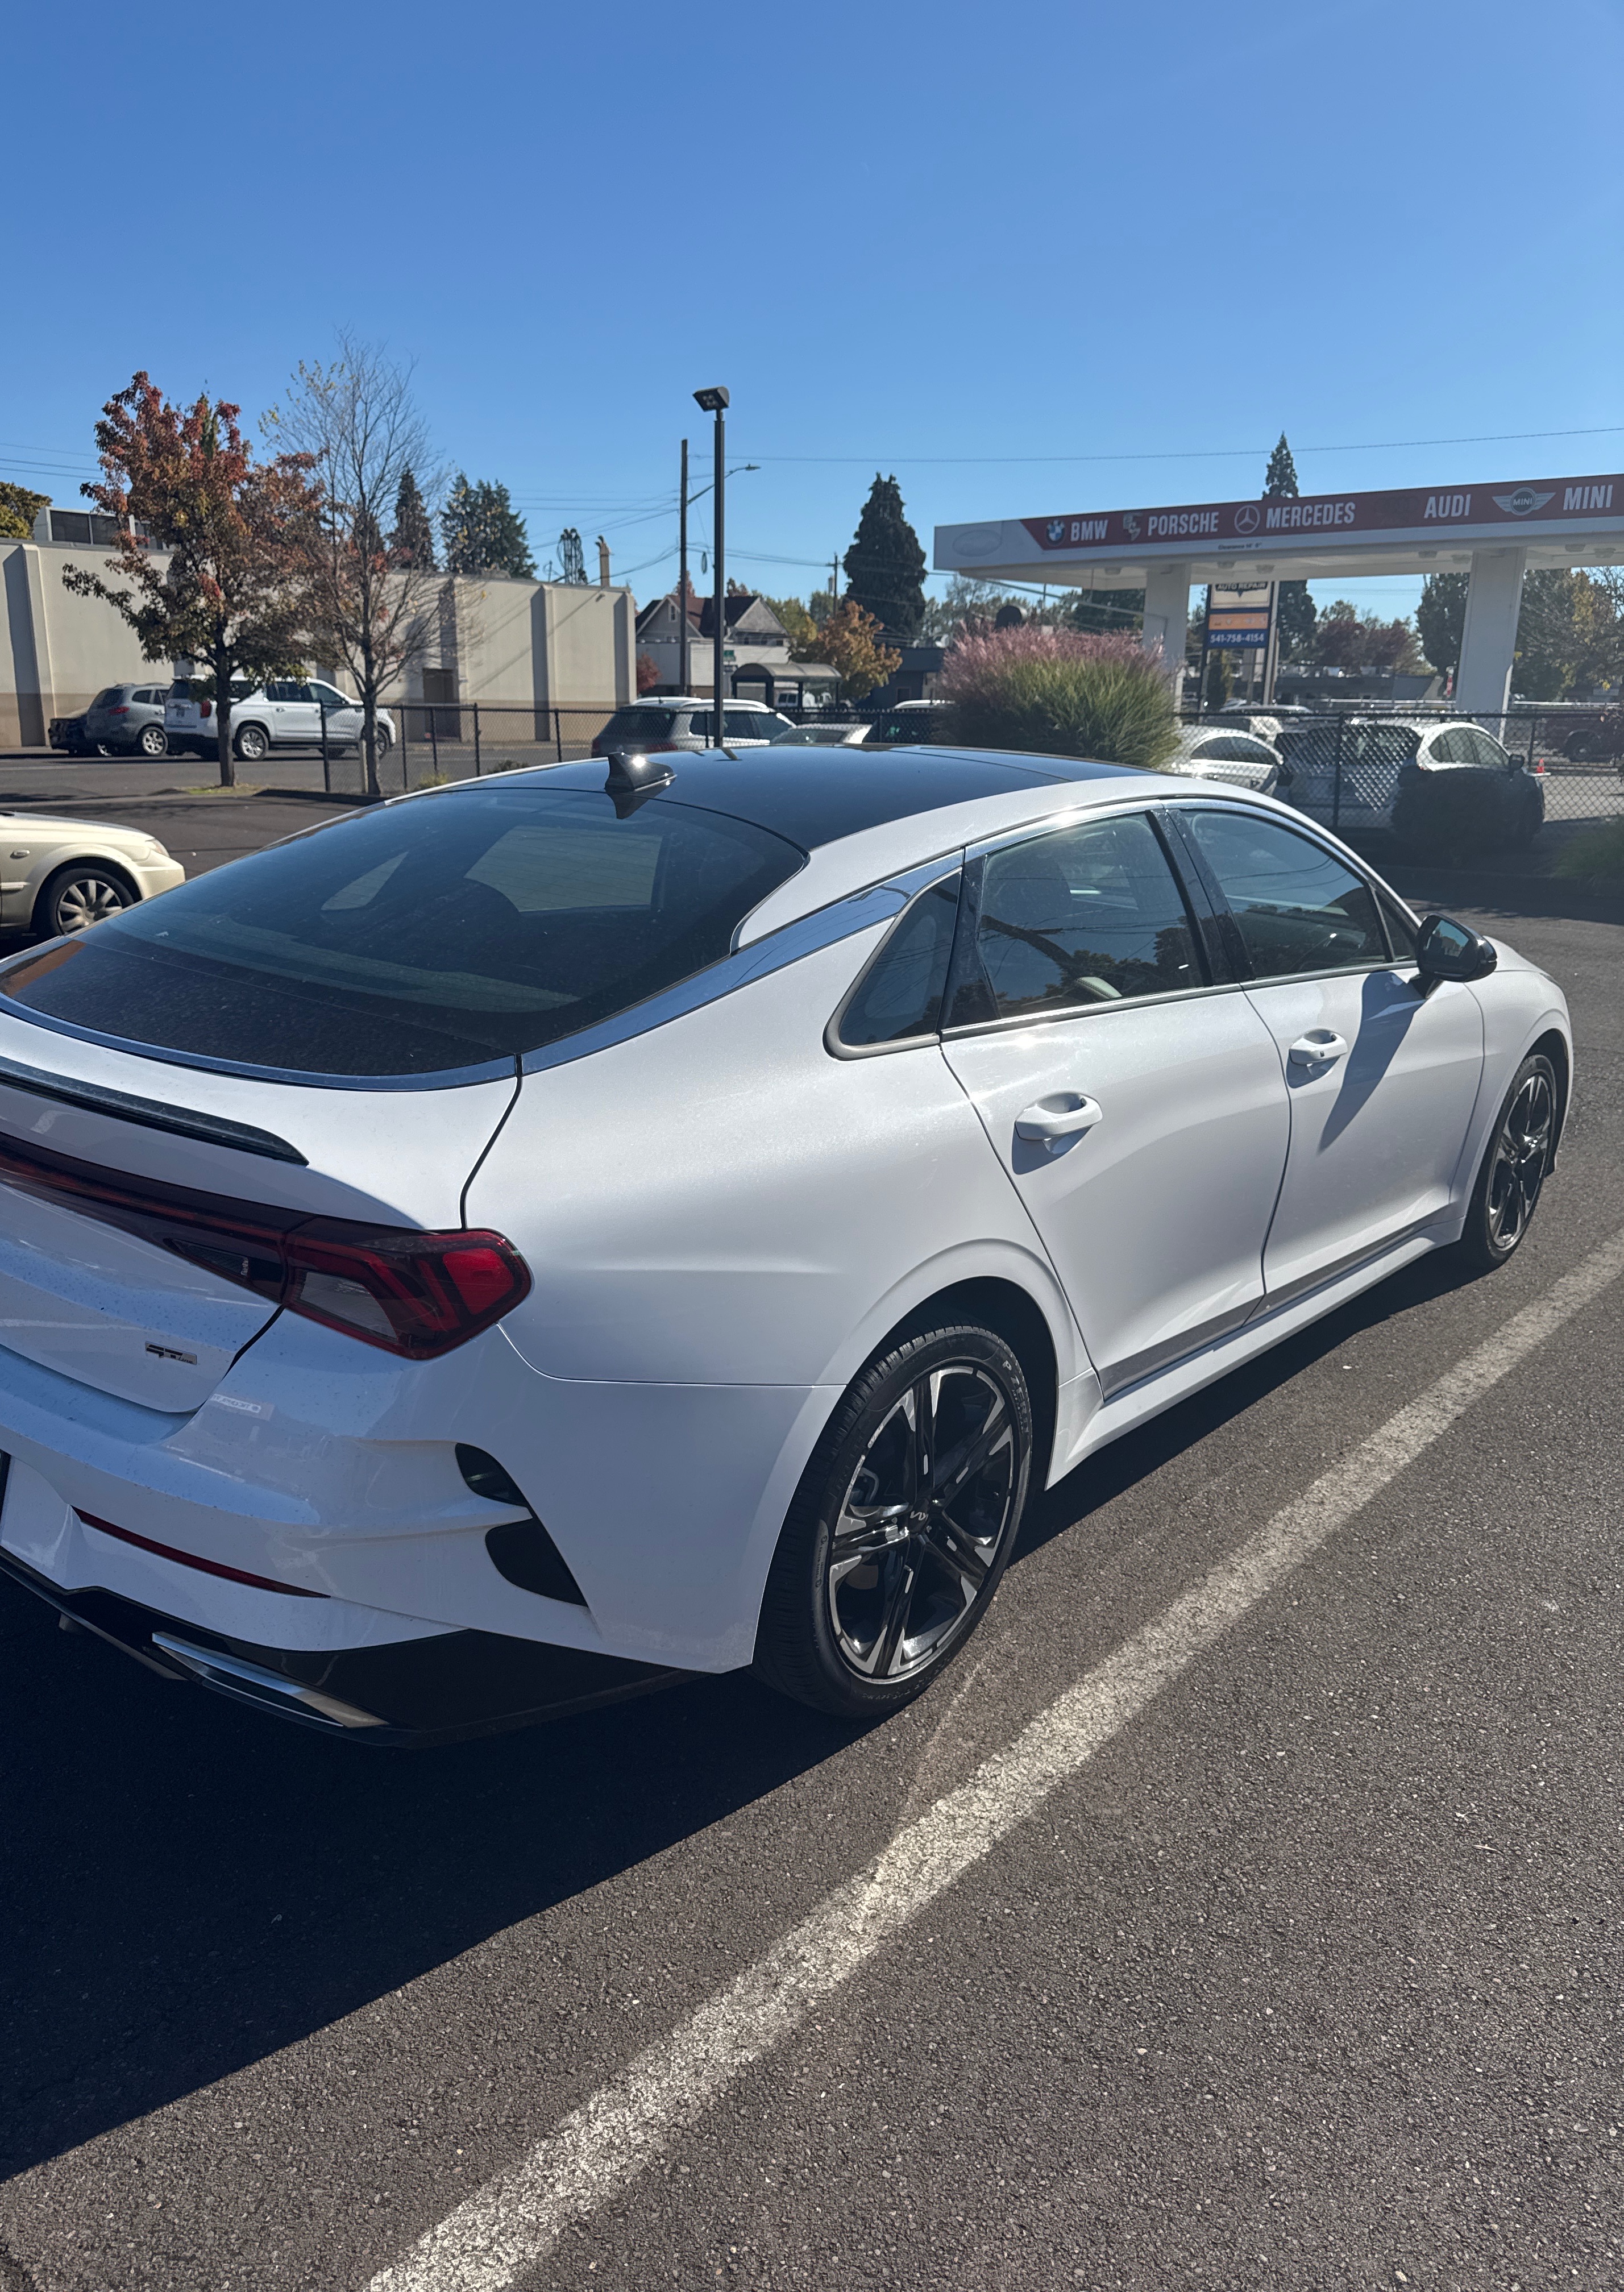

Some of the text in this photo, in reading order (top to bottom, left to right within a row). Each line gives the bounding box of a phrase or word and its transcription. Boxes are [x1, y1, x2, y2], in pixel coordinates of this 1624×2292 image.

[1424, 493, 1471, 518] AUDI
[1563, 484, 1613, 510] MINI
[1147, 512, 1220, 537] PORSCHE
[1266, 501, 1356, 529] MERCEDES
[1070, 519, 1108, 542] BMW
[1210, 633, 1264, 643] 541-758-4154
